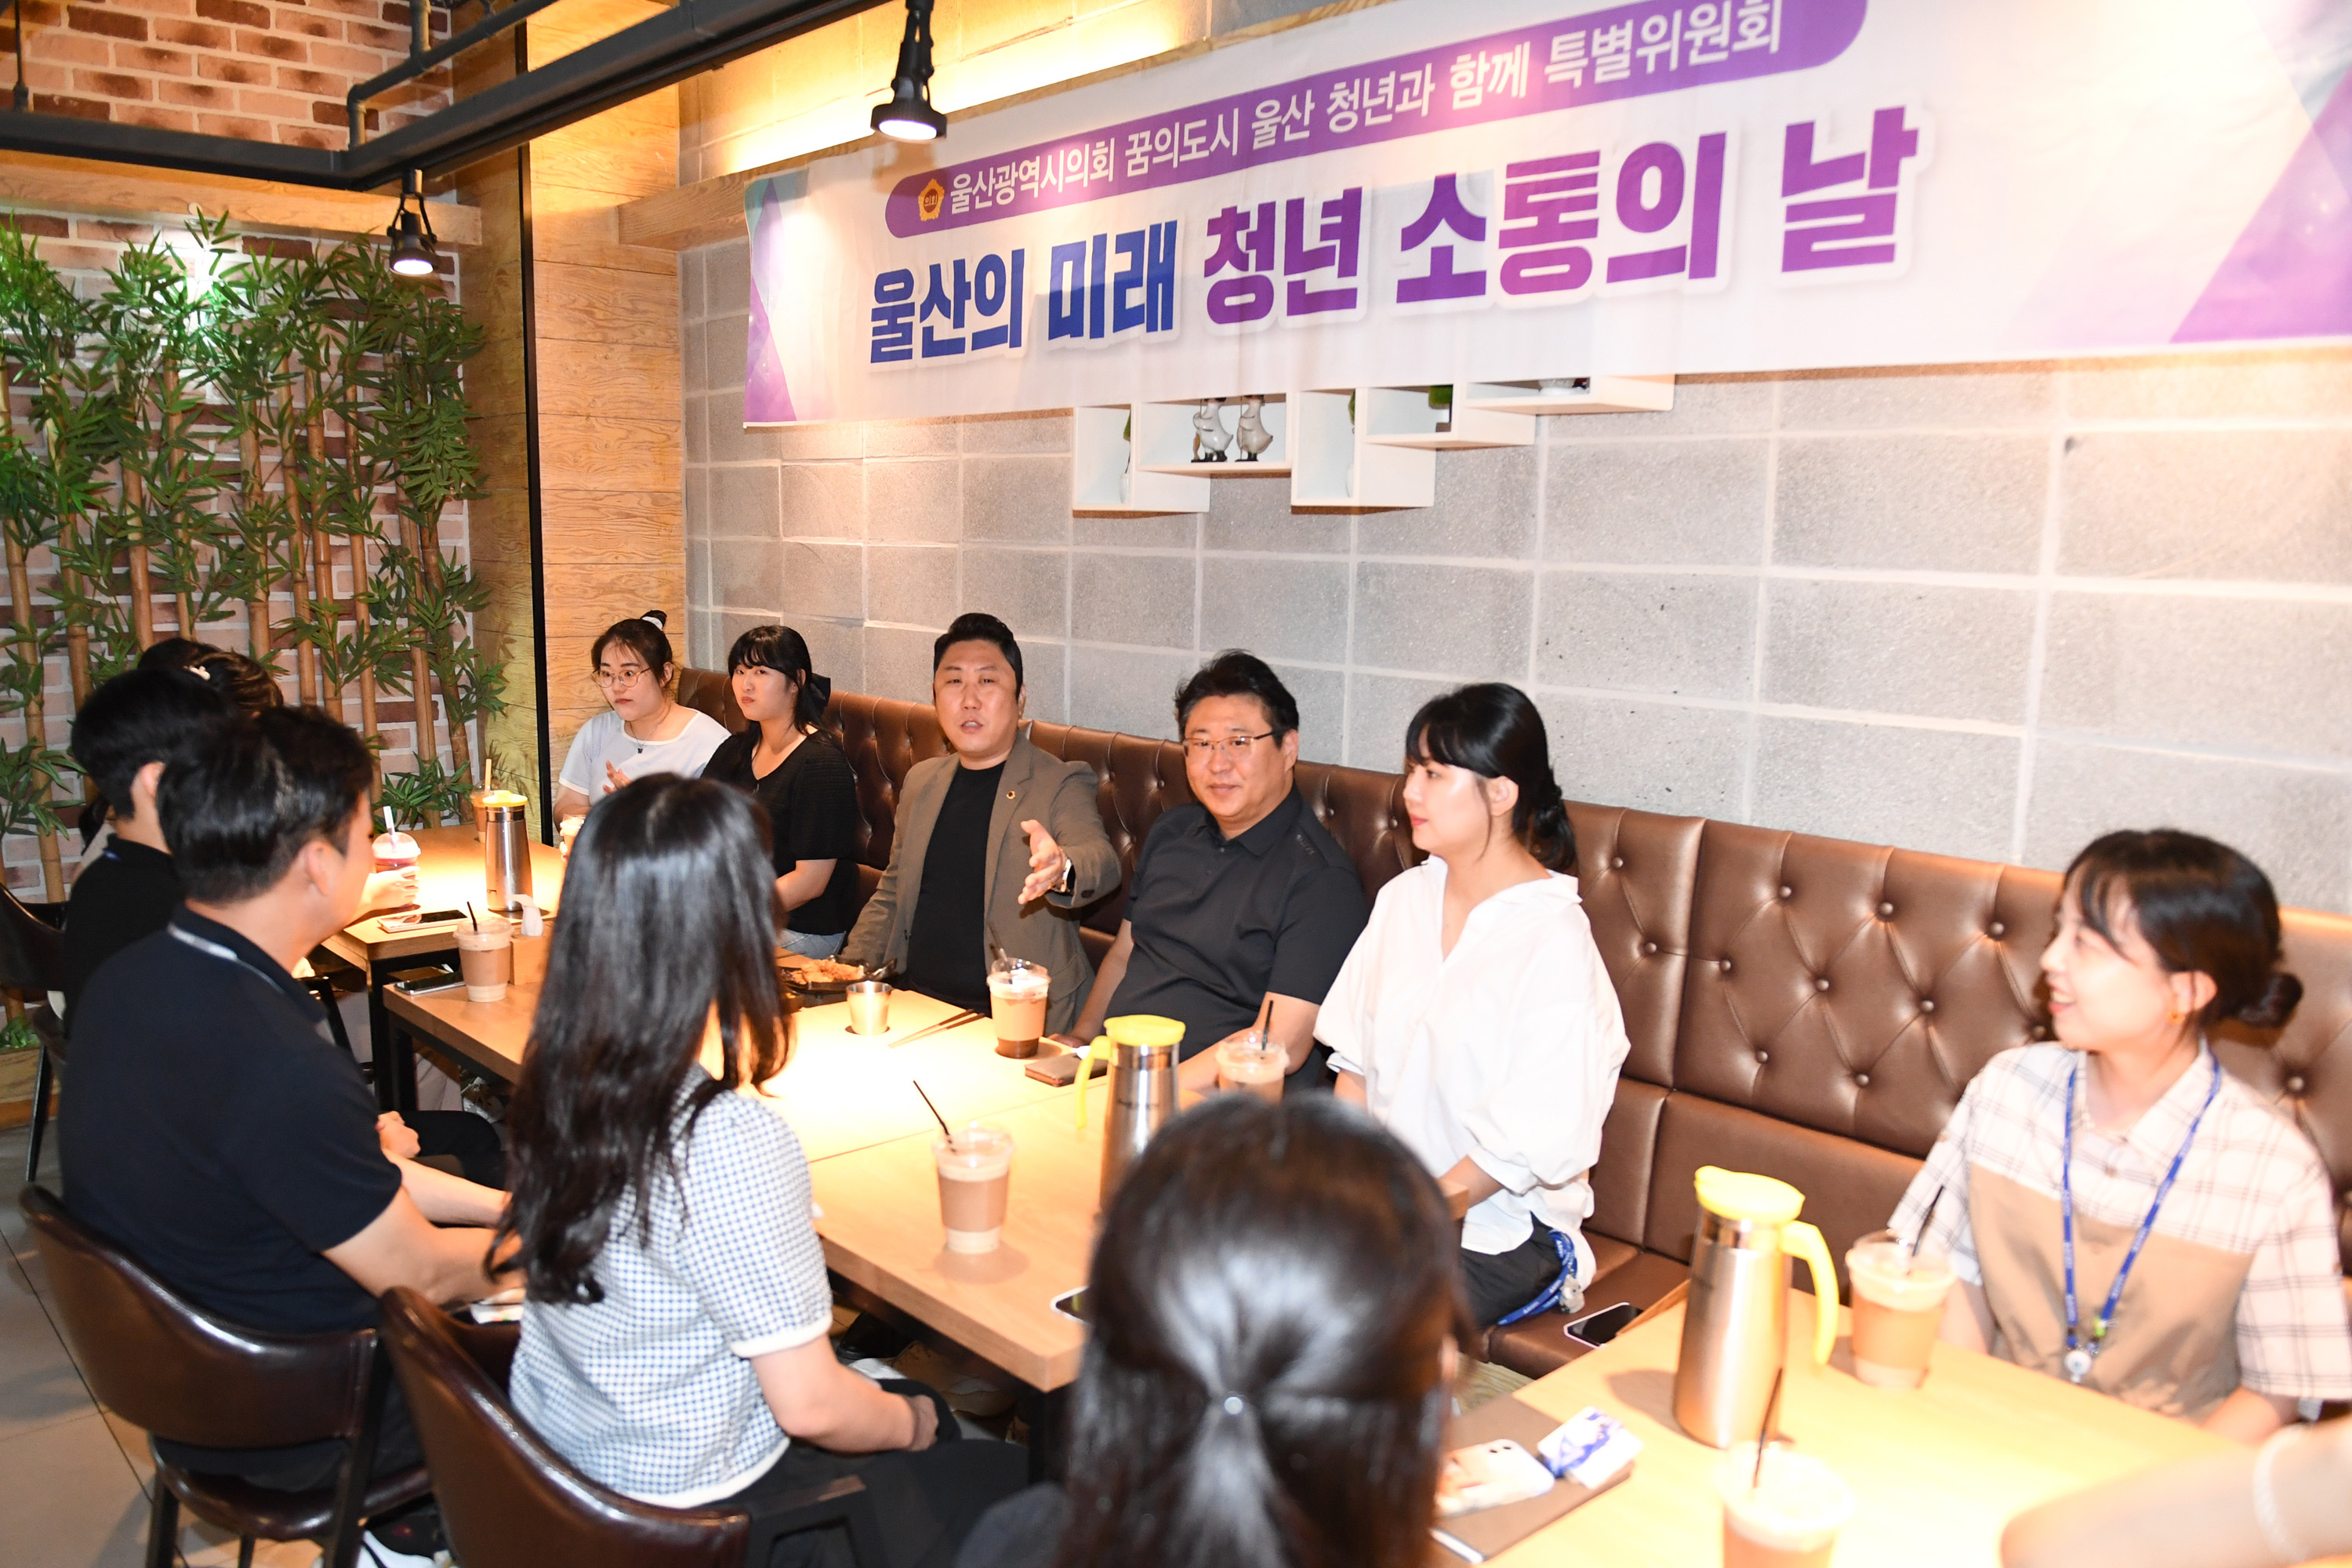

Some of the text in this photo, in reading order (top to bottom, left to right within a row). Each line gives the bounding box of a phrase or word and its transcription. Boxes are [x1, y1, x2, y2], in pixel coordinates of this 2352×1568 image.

[949, 0, 1783, 215] 울산광역시의회 꿈의도시 울산 청년과 함께 특별위원회
[870, 105, 1920, 364] 울산의 미래 청년 소통의 날
